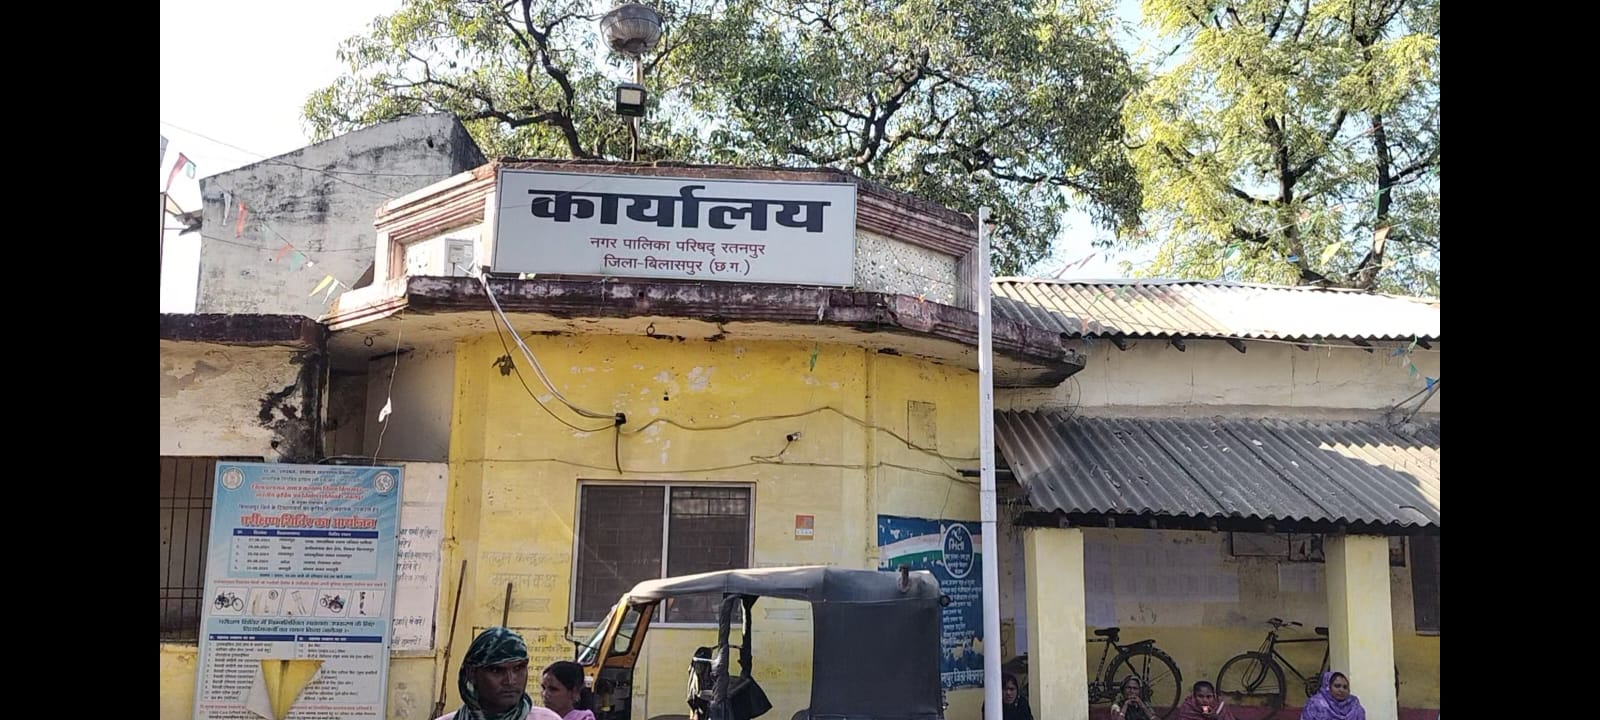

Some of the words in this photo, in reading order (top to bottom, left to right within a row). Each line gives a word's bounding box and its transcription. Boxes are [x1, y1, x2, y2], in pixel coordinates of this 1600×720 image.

[528, 185, 831, 233] कार्यालय
[590, 236, 617, 251] नगर
[623, 237, 670, 252] पालिका
[676, 240, 717, 256] परिषद्
[721, 242, 765, 258] रतनपुर
[604, 255, 703, 276] जिला-बिलासपुर
[709, 259, 751, 275] (छ.ग.)
